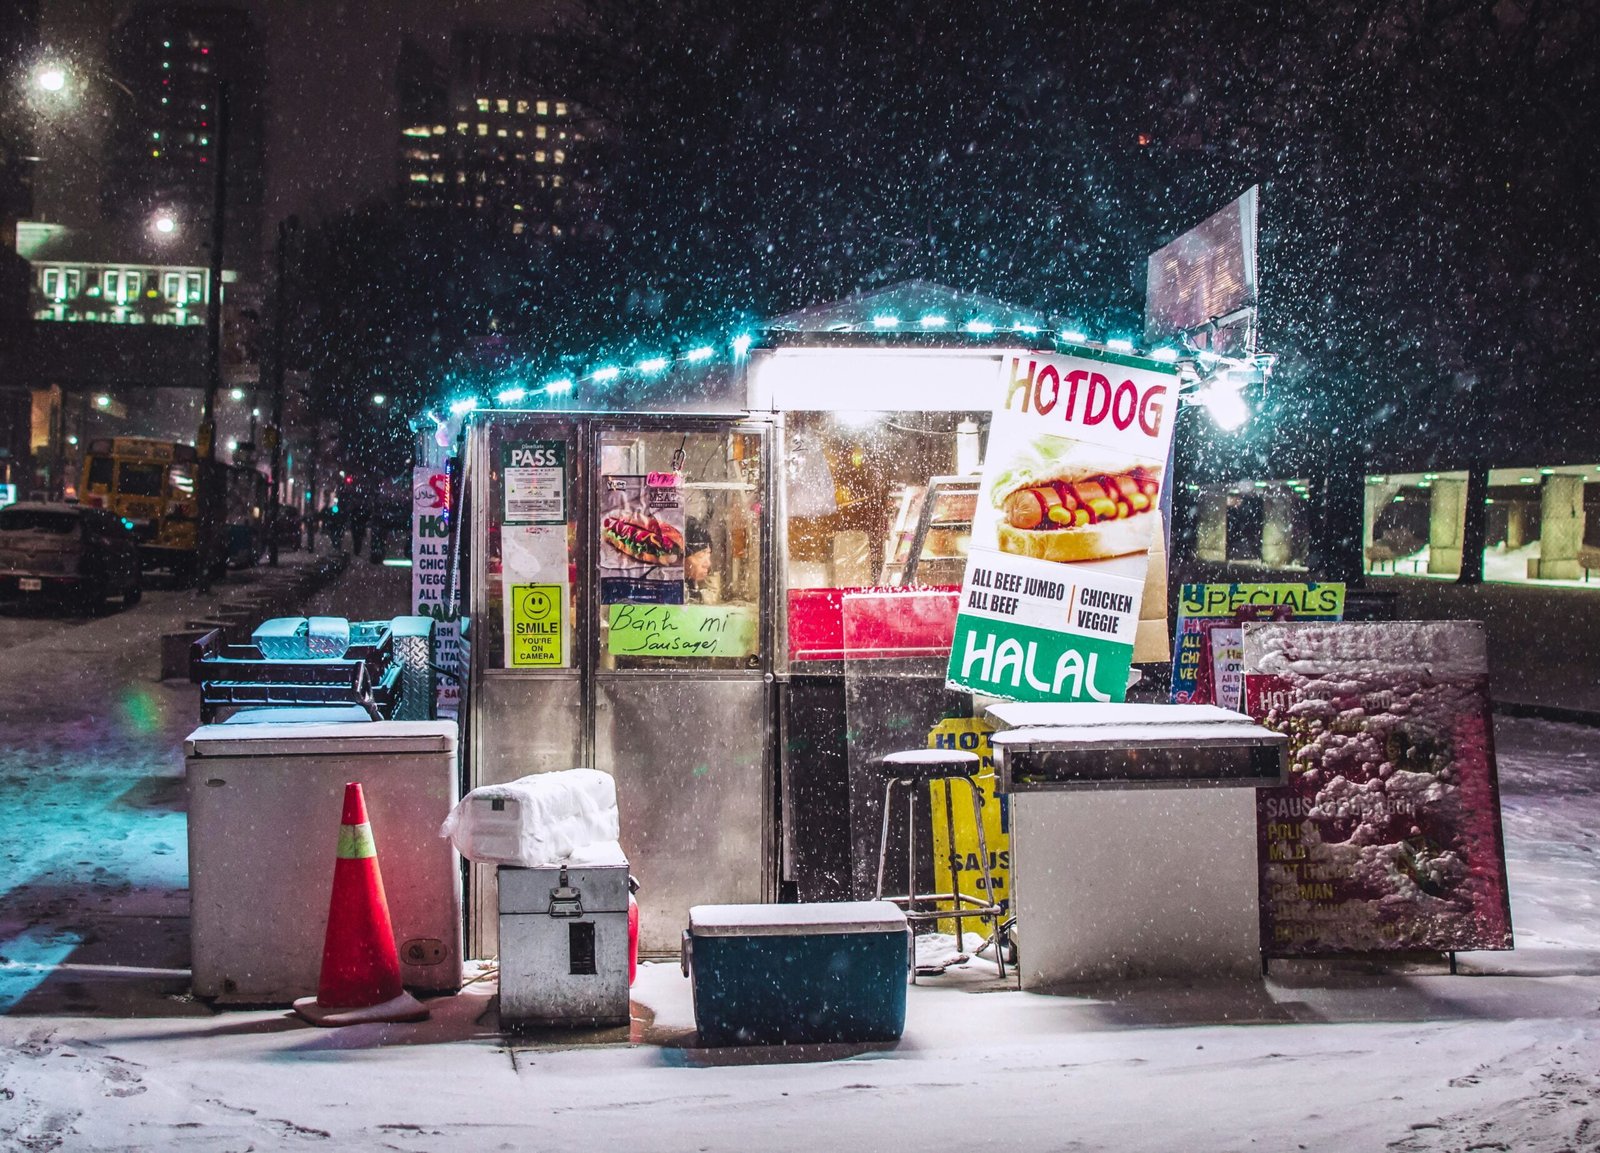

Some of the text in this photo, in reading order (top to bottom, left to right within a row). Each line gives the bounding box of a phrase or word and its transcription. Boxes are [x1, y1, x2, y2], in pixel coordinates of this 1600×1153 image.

[1004, 357, 1167, 438] HOTDOG
[511, 449, 556, 467] PASS
[419, 544, 438, 556] ALL
[419, 588, 438, 600] ALL
[972, 568, 1066, 601] ALL BEEF JUMBO
[968, 590, 1020, 616] ALL BEEF
[1080, 587, 1133, 614] CHICKEN
[1185, 589, 1337, 613] SPECIALS
[516, 622, 558, 634] SMILE
[1077, 610, 1120, 634] VEGGIE
[522, 637, 552, 645] YOU'RE
[961, 630, 1112, 703] HALAL
[1180, 652, 1201, 665] CHI
[948, 852, 1010, 871] SAUS
